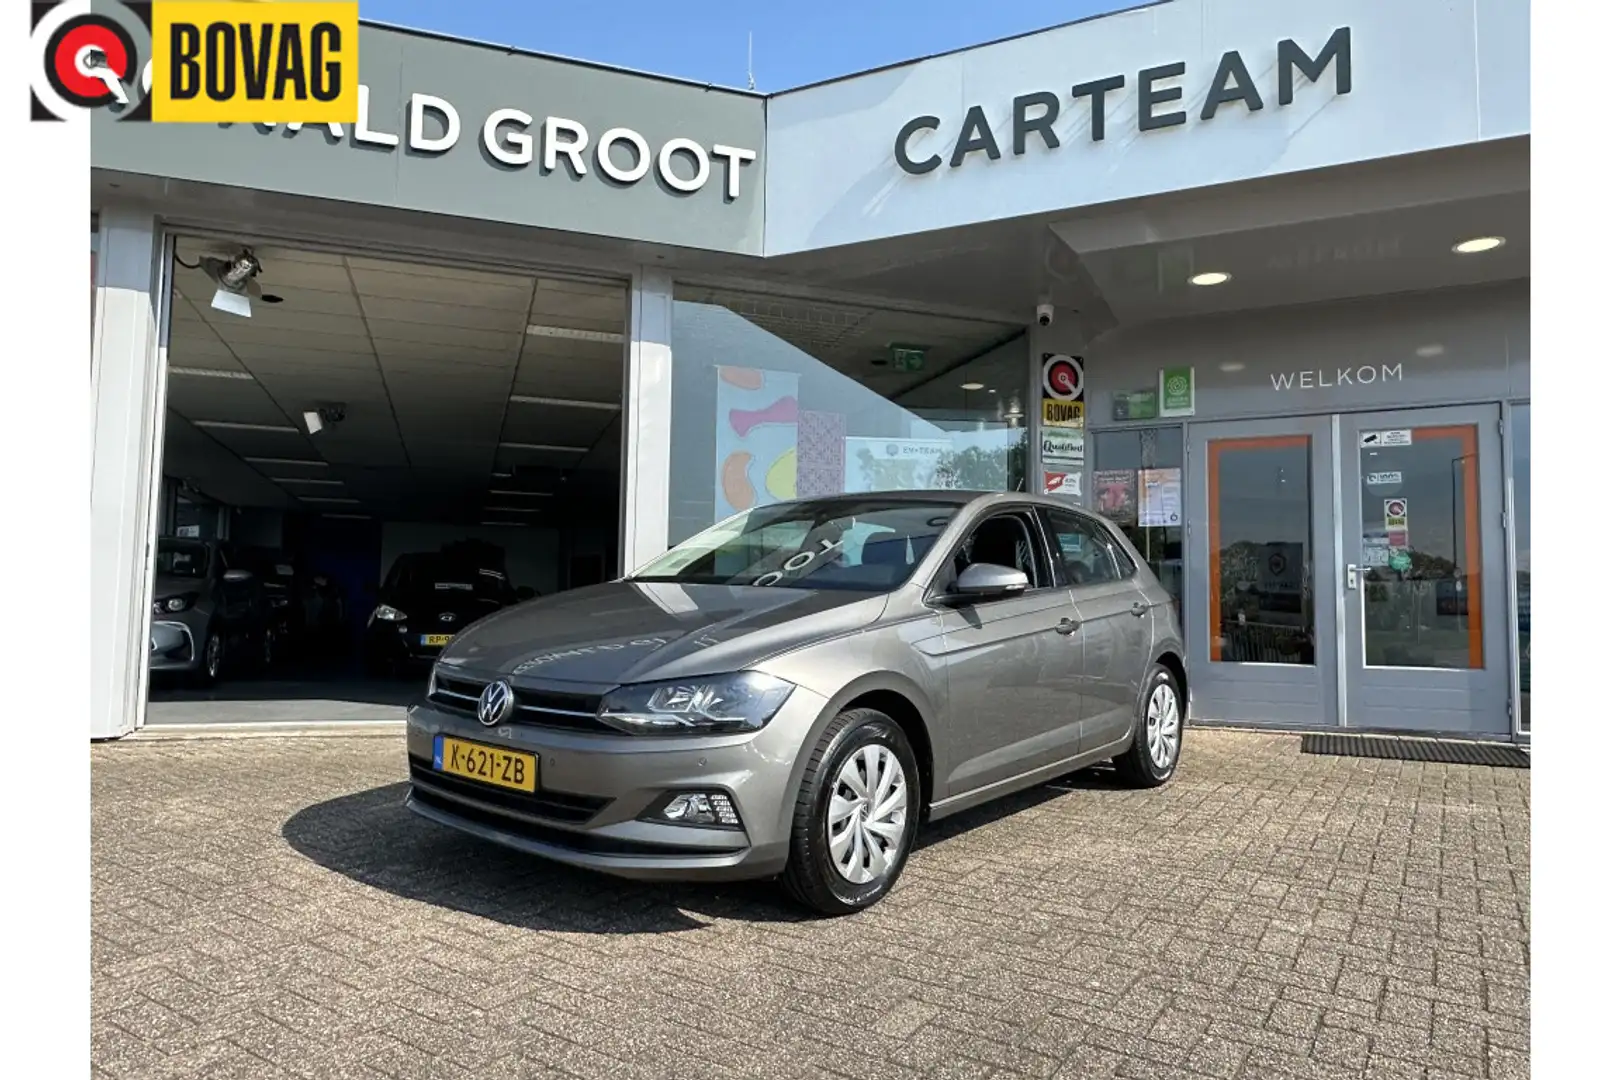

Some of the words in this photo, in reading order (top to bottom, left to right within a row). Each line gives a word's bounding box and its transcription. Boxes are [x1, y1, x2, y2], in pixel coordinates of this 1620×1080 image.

[894, 26, 1352, 176] CARTEAM
[484, 108, 756, 198] GROOT
[1270, 363, 1403, 391] WELKOM
[1046, 403, 1081, 421] BOVAG
[451, 743, 525, 784] K-621-ZB
